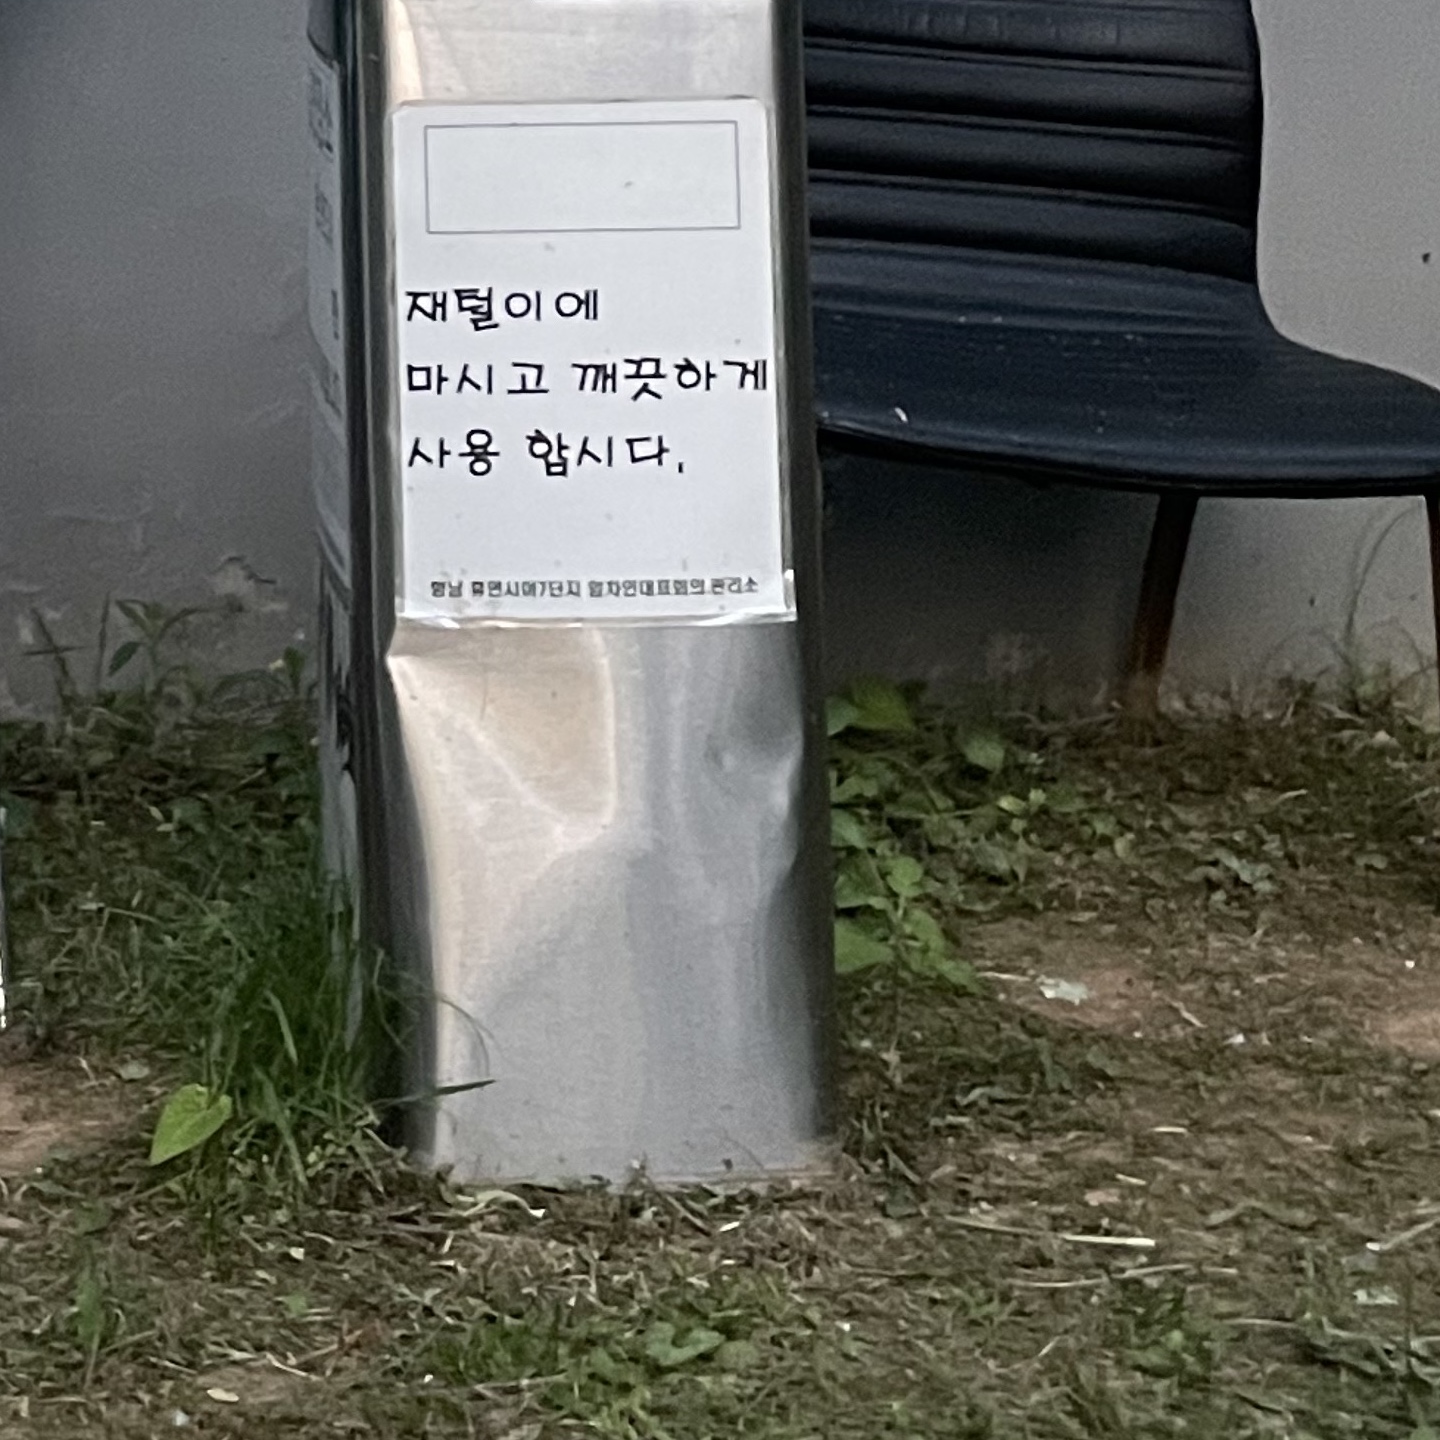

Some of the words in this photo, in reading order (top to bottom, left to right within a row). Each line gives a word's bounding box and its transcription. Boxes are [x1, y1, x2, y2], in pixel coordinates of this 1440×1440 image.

[406, 287, 597, 331] 재털이에
[407, 362, 549, 395] 마시고
[572, 358, 766, 401] 깨끗하게
[408, 429, 499, 476] 사용
